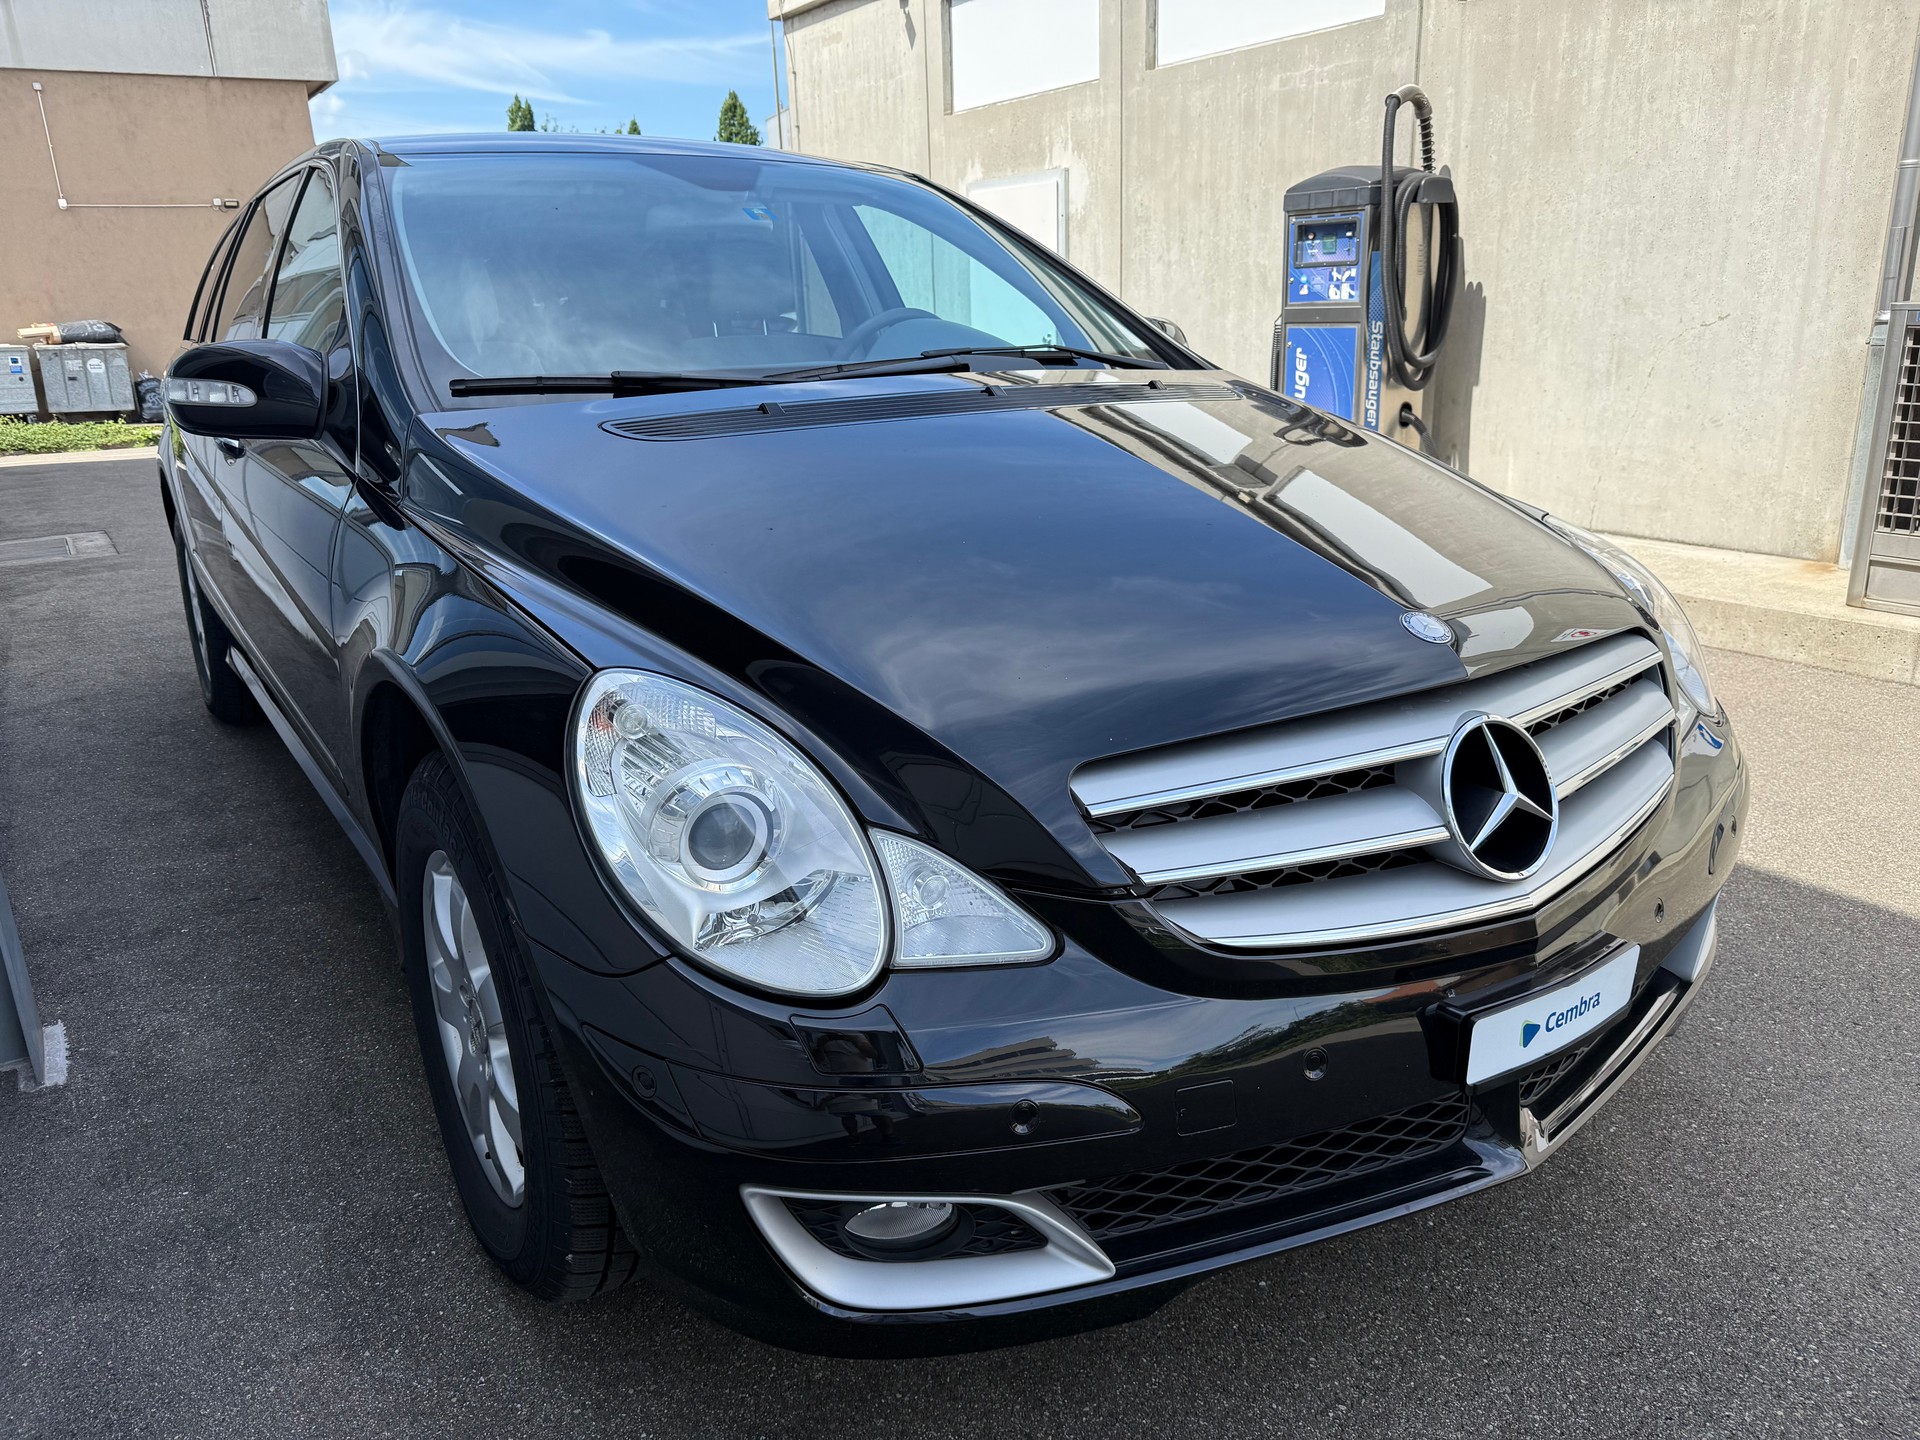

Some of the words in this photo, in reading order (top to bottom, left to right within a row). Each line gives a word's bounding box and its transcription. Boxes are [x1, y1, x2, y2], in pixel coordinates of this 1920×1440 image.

[1294, 347, 1309, 402] uger
[1365, 320, 1383, 426] Staubsauger
[1545, 992, 1601, 1033] Cembra
